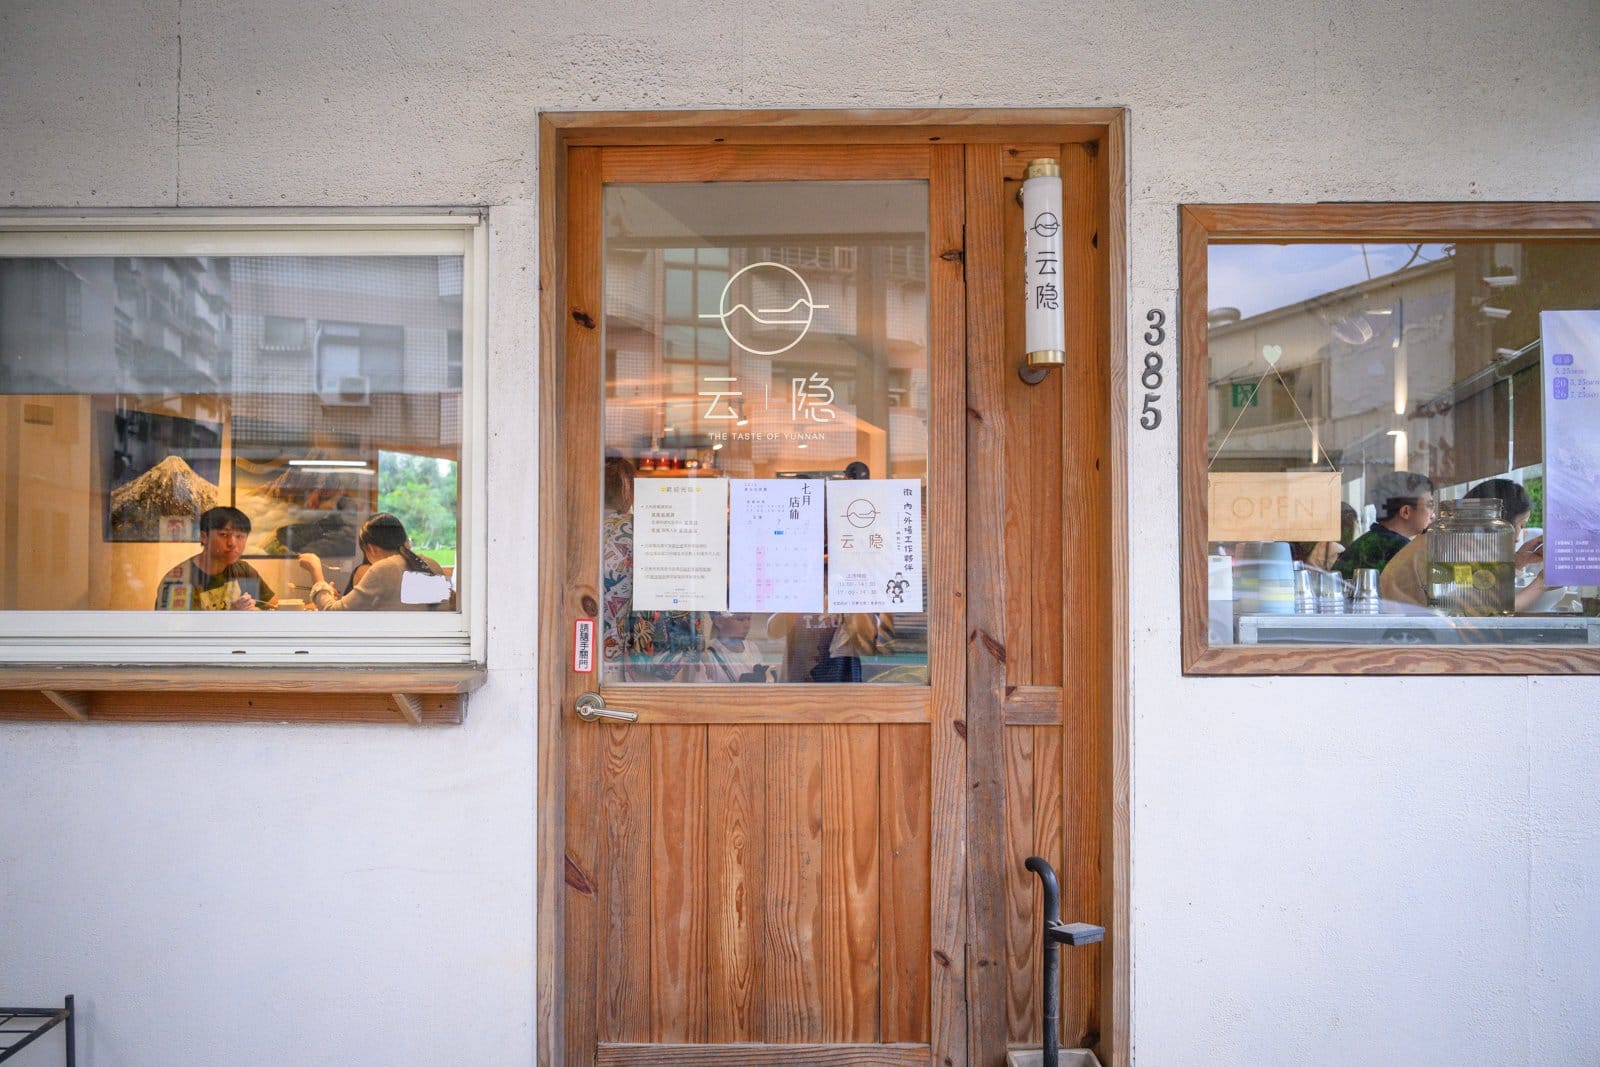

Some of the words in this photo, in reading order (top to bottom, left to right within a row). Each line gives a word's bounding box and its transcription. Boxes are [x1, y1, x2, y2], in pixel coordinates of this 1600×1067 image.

[1035, 250, 1059, 310] 云隐
[1140, 308, 1166, 431] 385
[708, 432, 728, 441] THE
[732, 432, 762, 441] TASTE
[766, 432, 780, 441] OF
[783, 432, 826, 441] YUNNAN
[801, 482, 812, 506] 七月
[1232, 496, 1315, 520] OPEN
